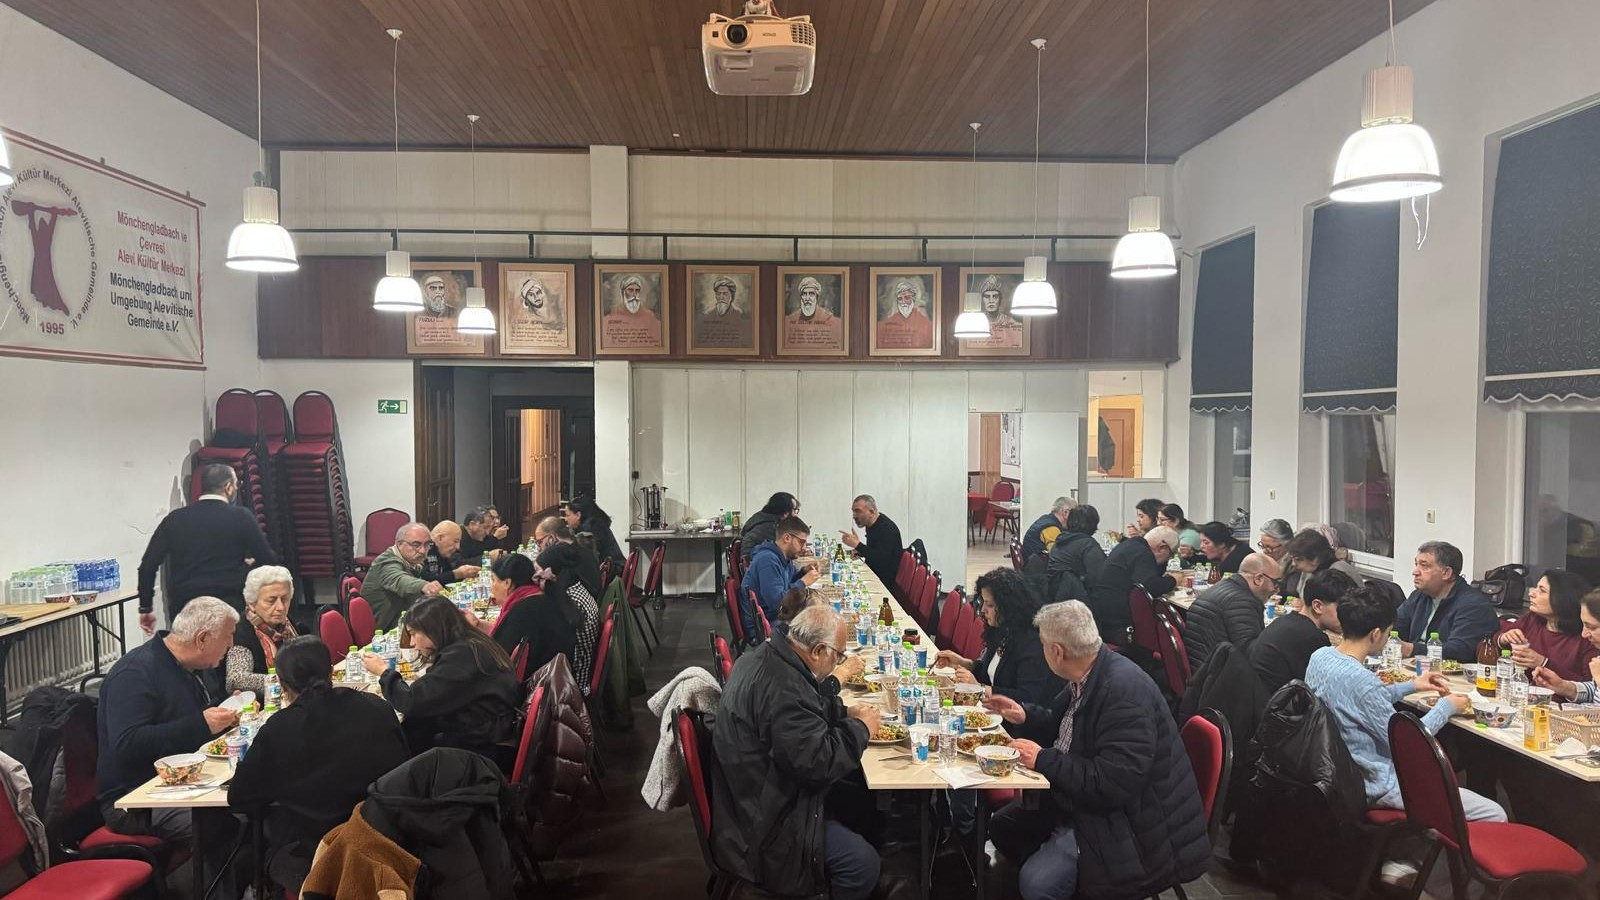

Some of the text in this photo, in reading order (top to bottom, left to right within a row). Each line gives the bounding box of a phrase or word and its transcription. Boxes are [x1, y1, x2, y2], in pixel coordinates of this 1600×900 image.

[43, 169, 73, 196] Merkezi
[72, 196, 96, 257] Alevitische
[117, 210, 180, 240] Mönchengladbach
[139, 236, 166, 255] Çevresi
[117, 248, 186, 277] Alevi Kültür Merkezi
[81, 261, 98, 315] Gemeinde
[110, 271, 193, 302] Mönchengladbach un
[110, 292, 194, 319] Umgebung Alevitische
[39, 321, 65, 335] 1995
[127, 313, 179, 333] Gemeinde e.V.
